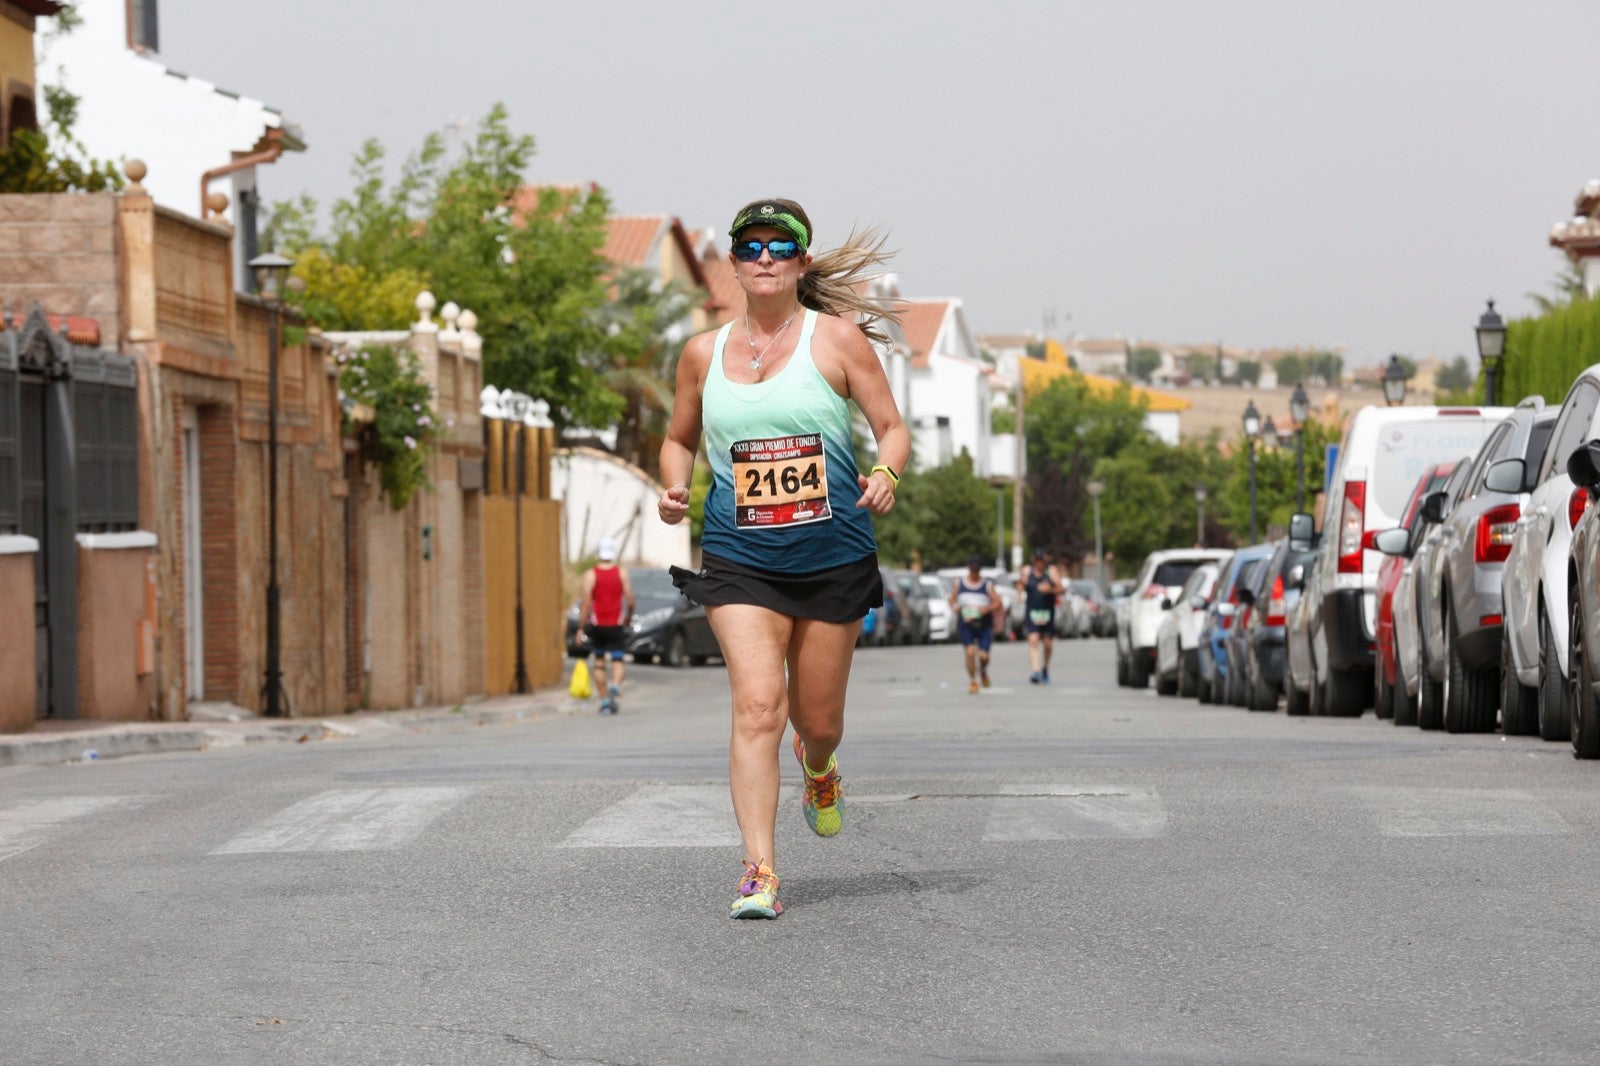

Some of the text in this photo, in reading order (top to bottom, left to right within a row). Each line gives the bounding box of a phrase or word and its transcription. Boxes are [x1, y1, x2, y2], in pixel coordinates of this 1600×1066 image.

[750, 441, 765, 452] GRAN
[765, 439, 786, 451] PREMIO
[786, 438, 795, 449] DE
[795, 436, 816, 448] FONDO
[746, 463, 820, 497] 2164
